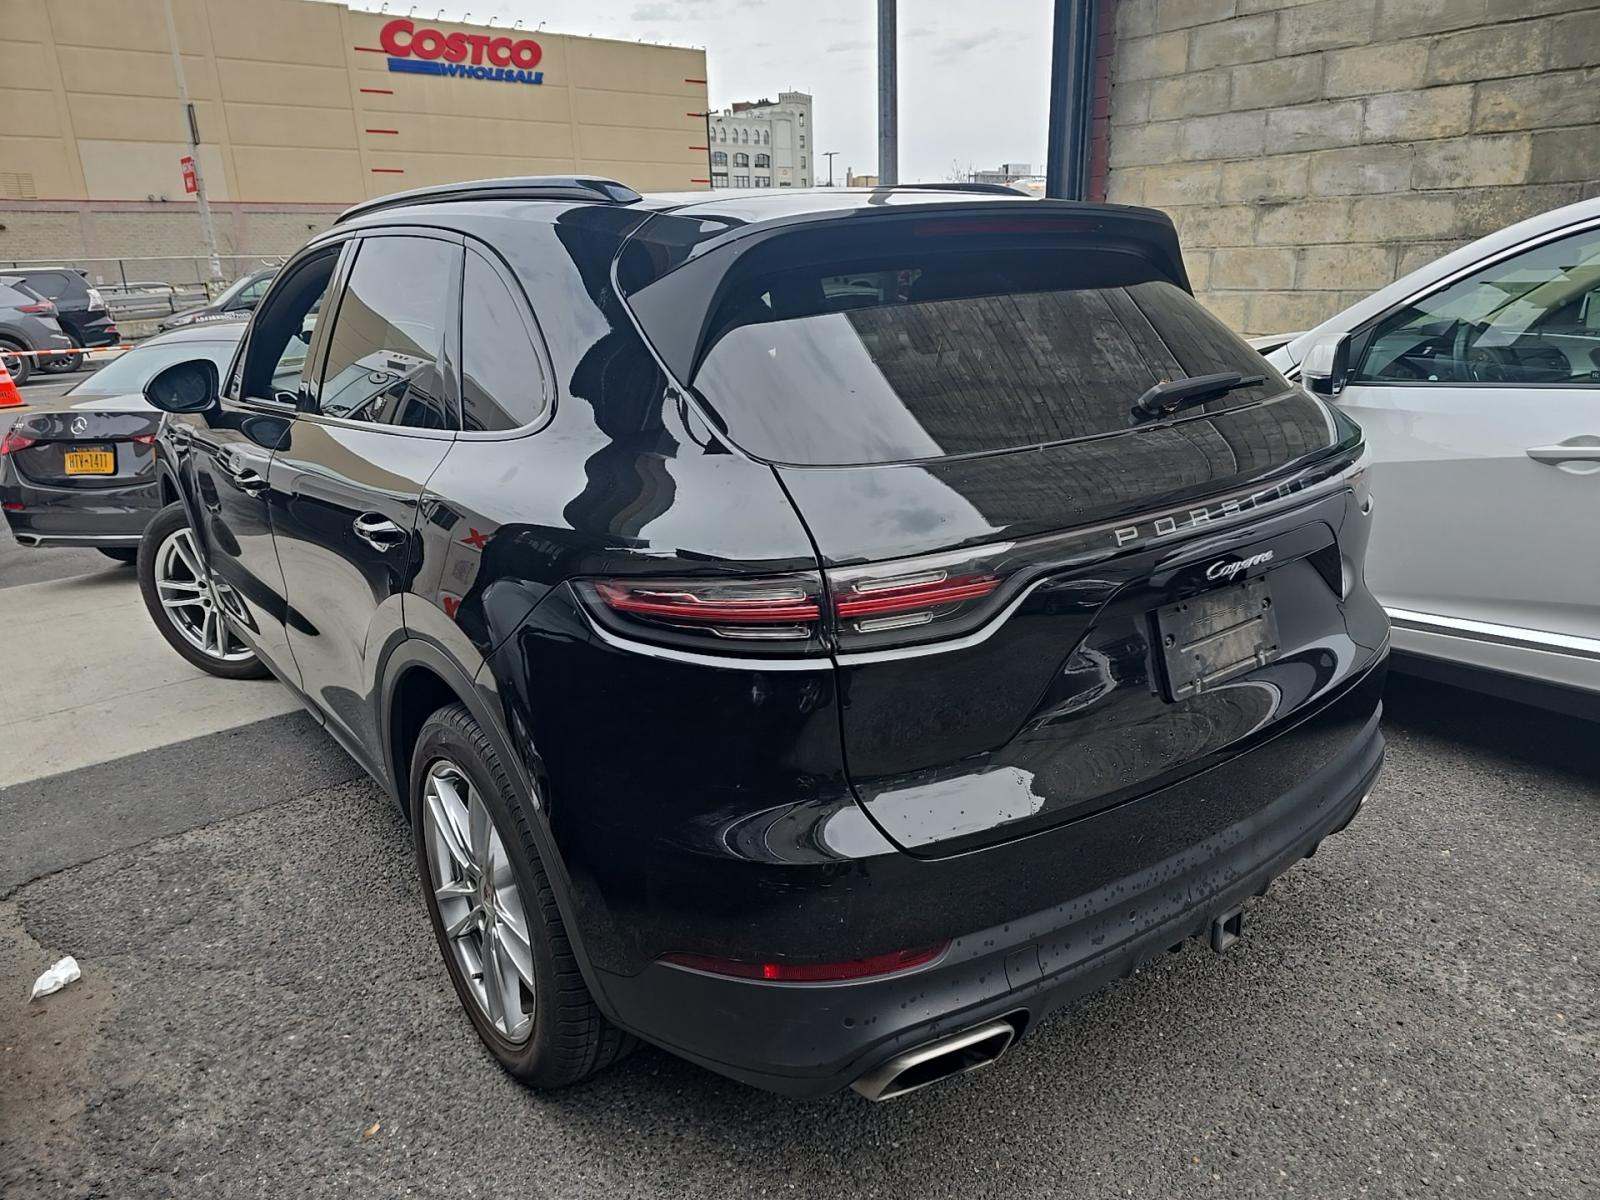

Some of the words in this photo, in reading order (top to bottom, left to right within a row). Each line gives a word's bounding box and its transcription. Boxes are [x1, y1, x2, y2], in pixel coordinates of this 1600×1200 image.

[380, 19, 543, 69] COSTCO
[440, 63, 544, 85] WHOLESALE
[1206, 550, 1275, 581] Cayenne
